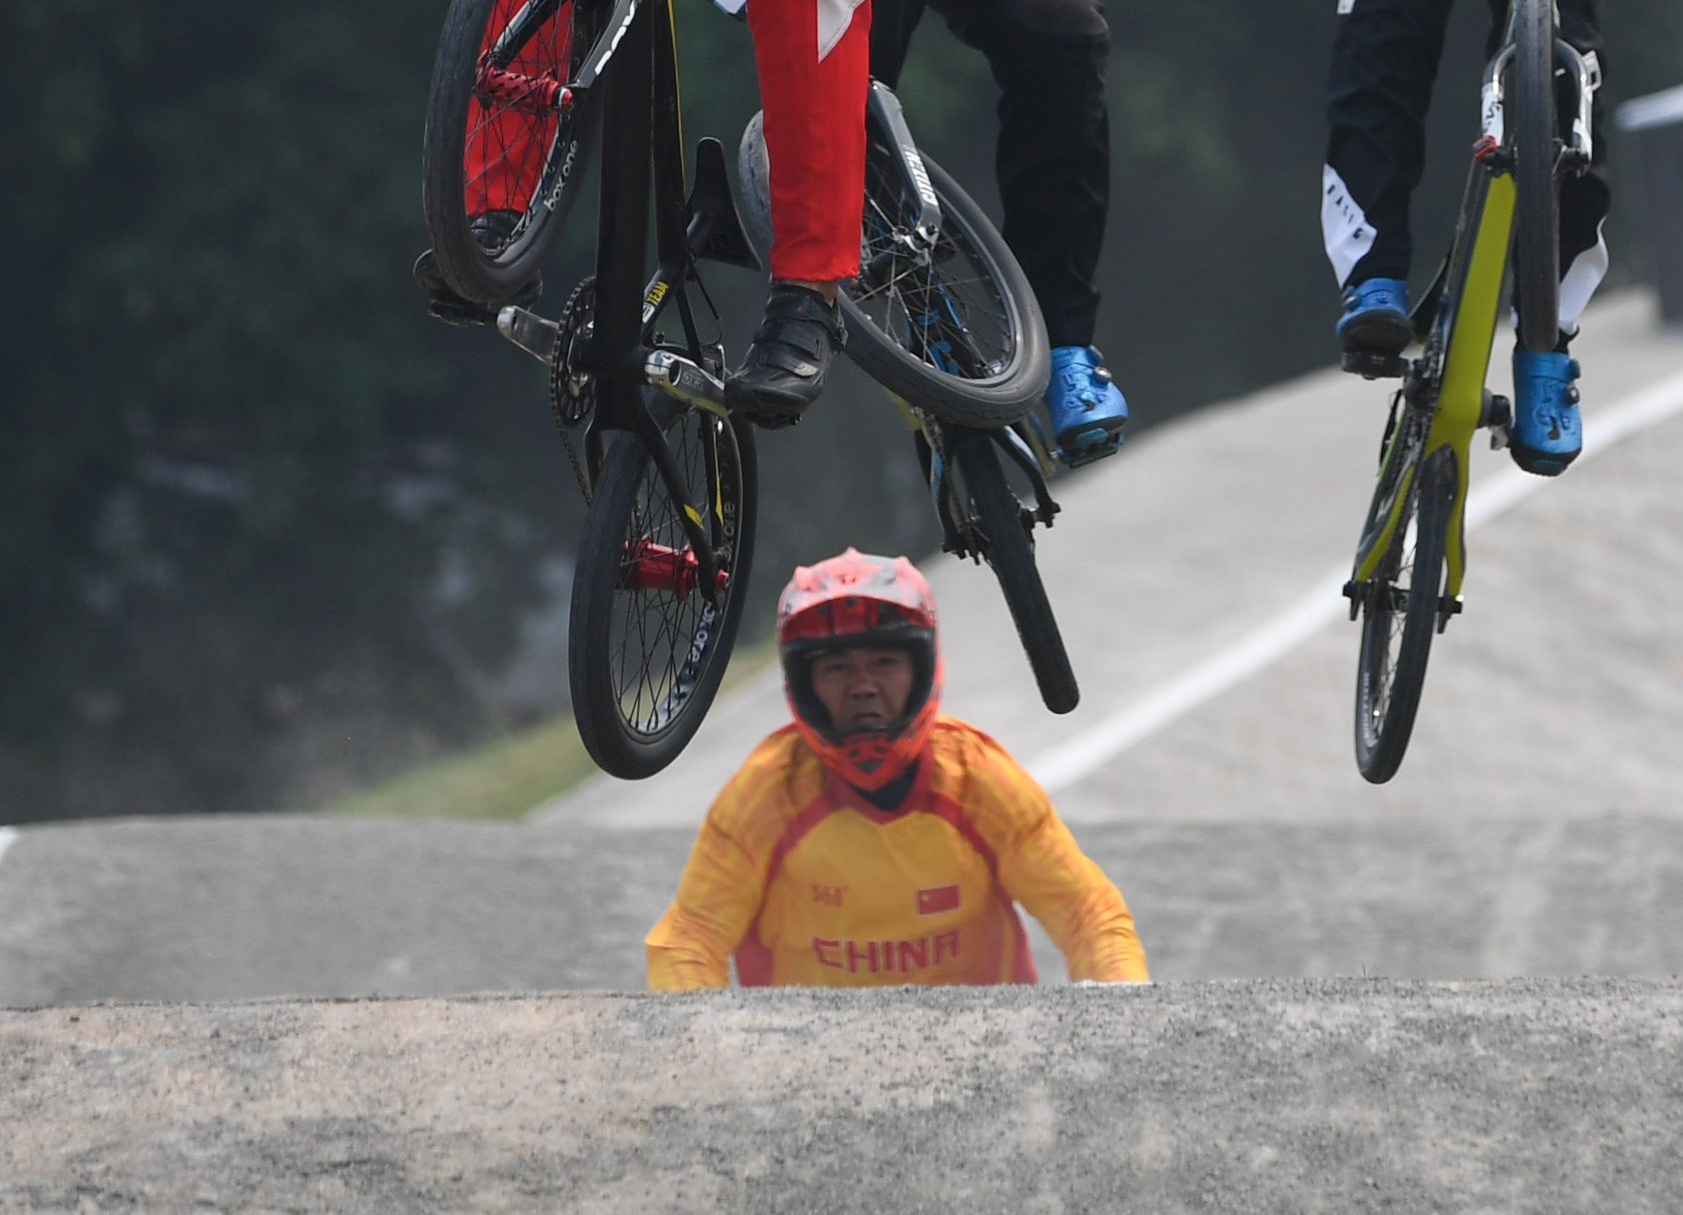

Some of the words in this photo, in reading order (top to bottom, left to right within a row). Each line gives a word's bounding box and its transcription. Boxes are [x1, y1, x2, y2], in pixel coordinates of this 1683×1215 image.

[543, 176, 566, 212] box
[562, 139, 578, 177] one
[645, 281, 670, 306] TEAM
[813, 928, 962, 973] CHINA
